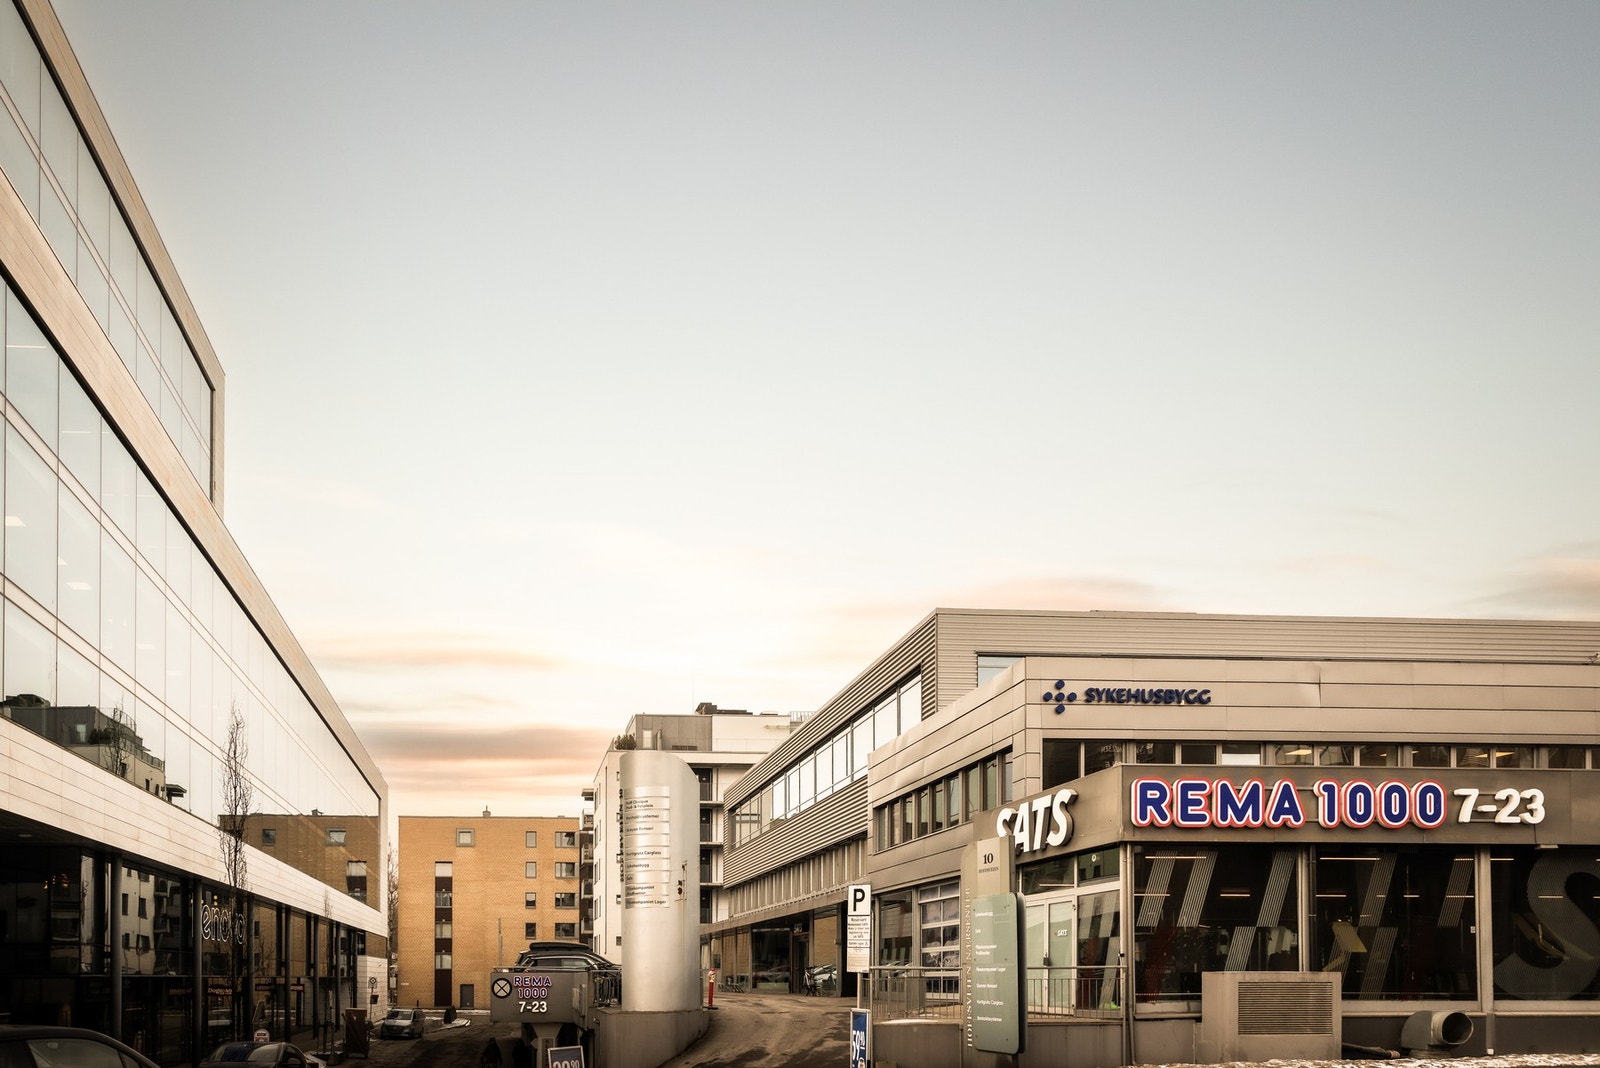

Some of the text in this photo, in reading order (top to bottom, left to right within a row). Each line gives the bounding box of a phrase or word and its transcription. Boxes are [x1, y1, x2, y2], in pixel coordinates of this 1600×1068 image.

[1084, 687, 1212, 704] SYKEHUSBYGG
[1131, 777, 1545, 829] REMA 1000 7-23
[996, 788, 1079, 853] SATS
[983, 852, 994, 864] 10
[853, 888, 866, 912] P
[513, 975, 552, 987] REMA
[517, 987, 548, 999] 1000
[518, 1001, 548, 1013] 7-23
